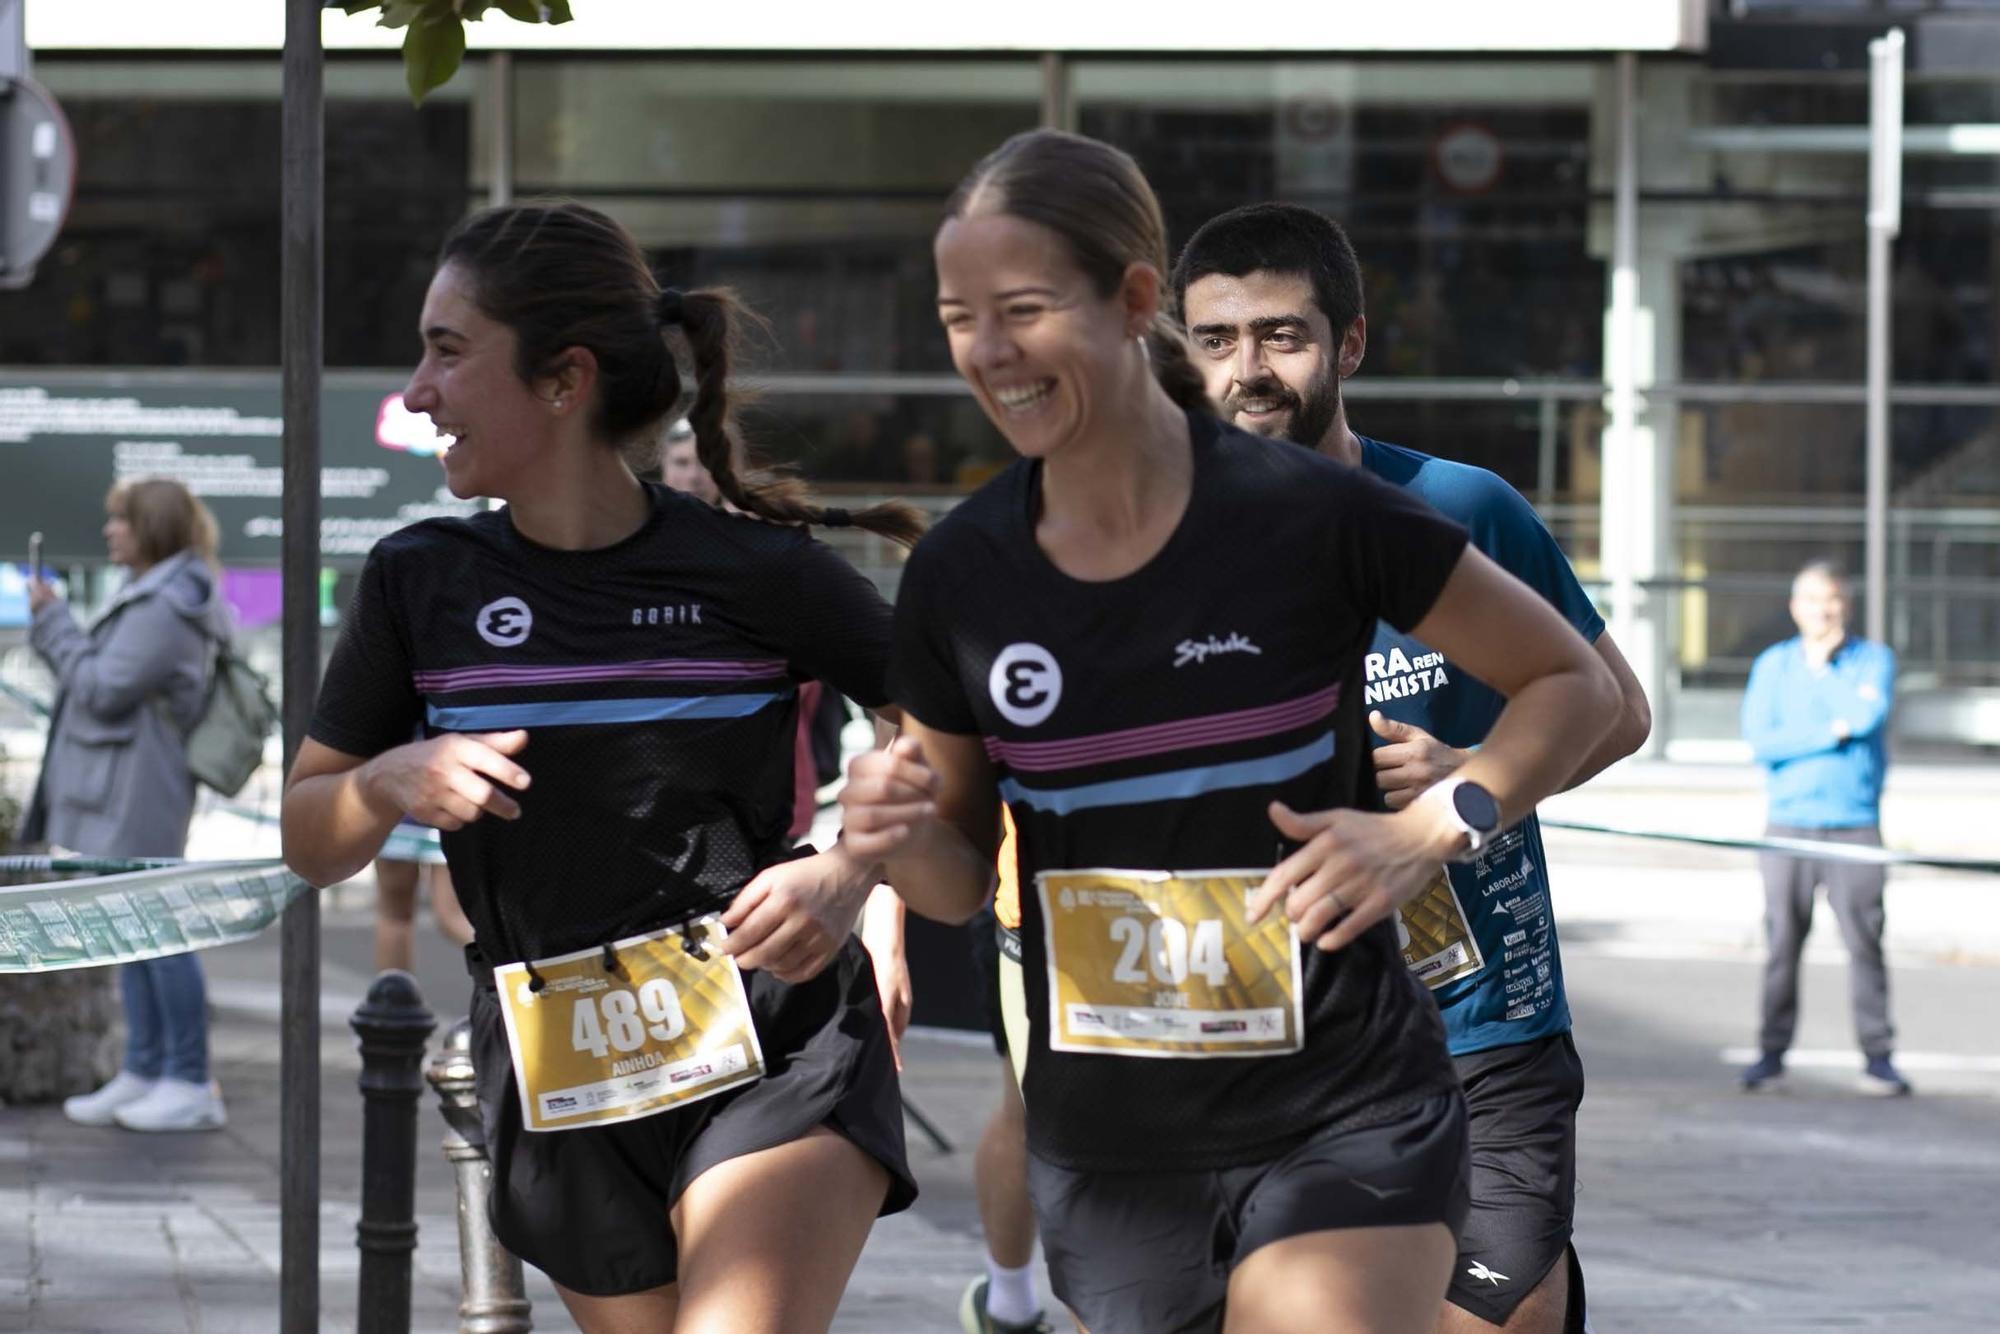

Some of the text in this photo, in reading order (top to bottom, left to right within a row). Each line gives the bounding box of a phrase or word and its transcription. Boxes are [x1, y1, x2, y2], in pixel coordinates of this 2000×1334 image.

[631, 603, 702, 626] GOBIK
[1412, 651, 1445, 671] REN
[1364, 667, 1450, 705] NKISTA
[1481, 870, 1526, 897] LABORAL
[1110, 916, 1230, 987] 204
[571, 977, 686, 1059] 489
[612, 1051, 666, 1078] AINHOA
